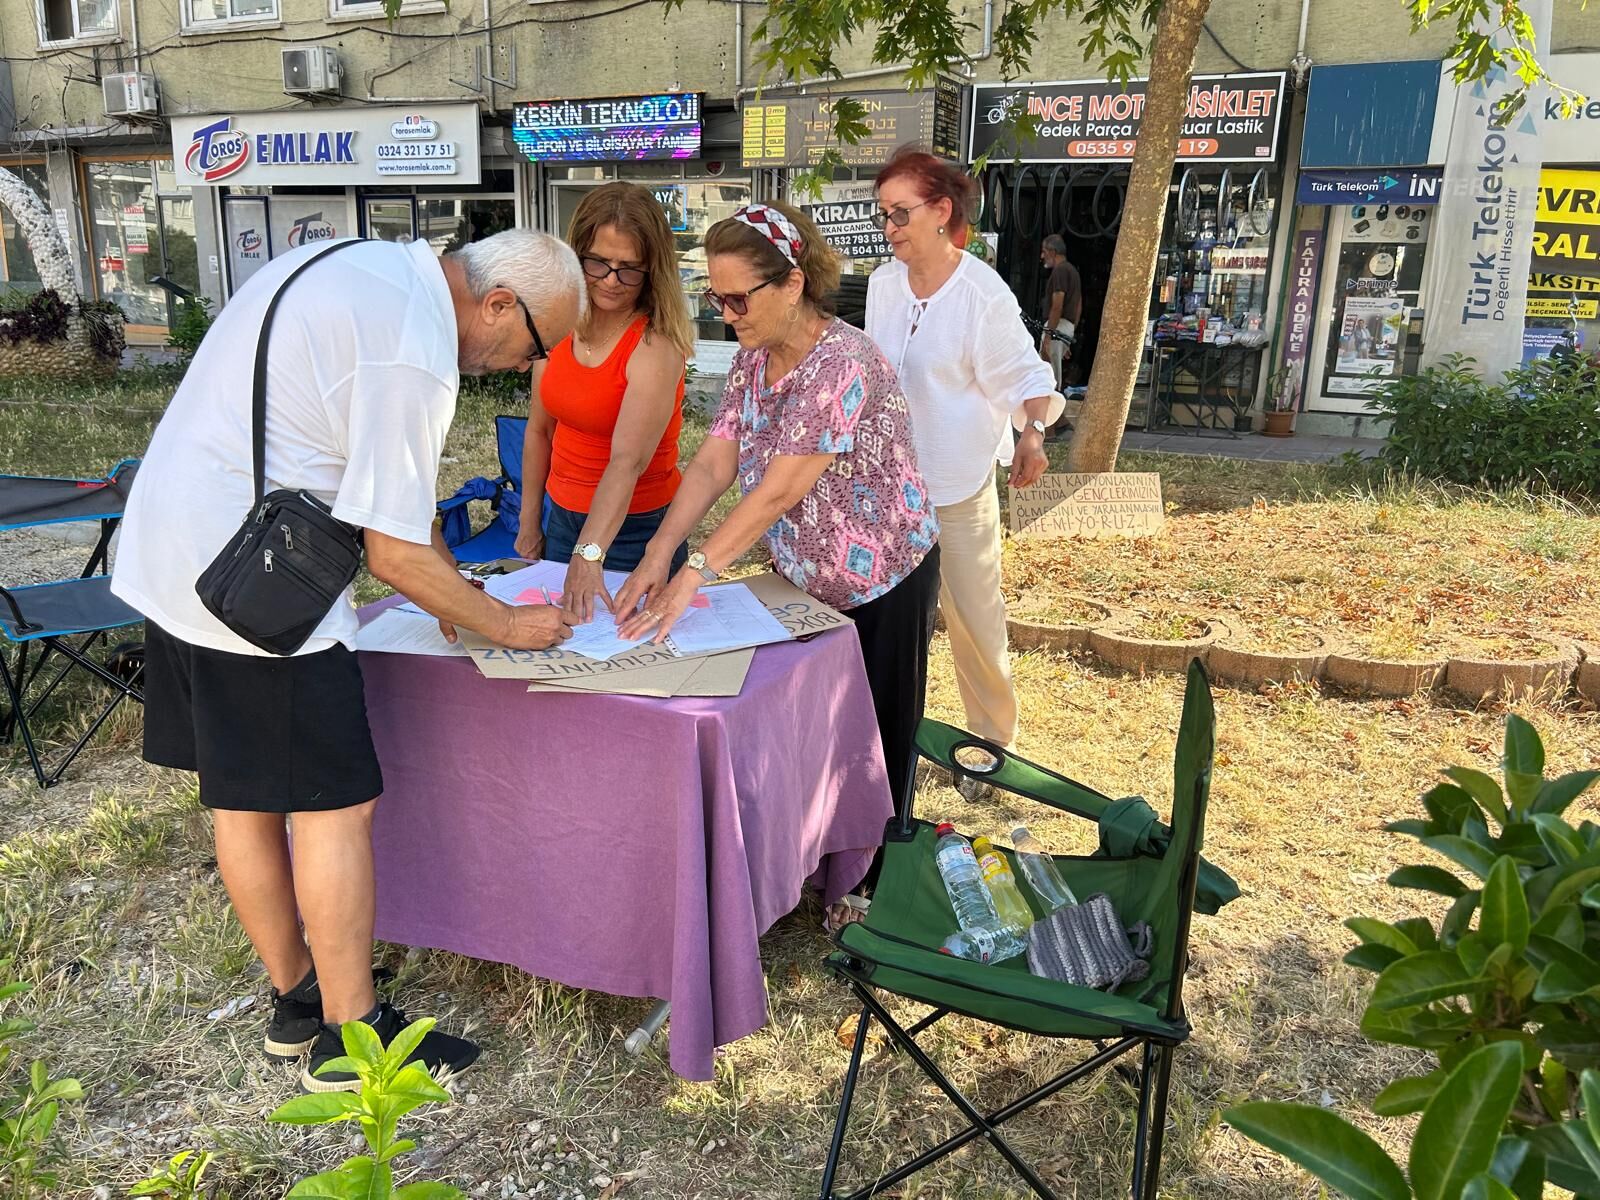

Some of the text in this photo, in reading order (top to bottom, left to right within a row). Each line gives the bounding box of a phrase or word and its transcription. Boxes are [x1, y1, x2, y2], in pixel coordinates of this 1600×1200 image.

[515, 94, 698, 127] KESKİN TEKNOLOJİ
[1026, 91, 1083, 122] İNCE
[1088, 93, 1146, 121] MOT
[395, 126, 432, 134] torosemlak
[1033, 123, 1081, 137] Yedek
[1085, 123, 1132, 140] Parça
[1216, 119, 1264, 134] Lastik
[256, 131, 354, 163] EMLAK
[378, 144, 451, 157] 0324 321 57 51
[518, 140, 567, 153] TELEFON
[568, 139, 584, 152] VE
[585, 135, 654, 151] BİLGİSAYAR
[1076, 142, 1118, 155] 0535
[1188, 141, 1209, 153] 19
[378, 163, 452, 171] www.torosemlak.com.tr
[1311, 181, 1379, 191] Türk Telekom
[834, 236, 851, 245] 532
[852, 235, 869, 243] 793
[871, 233, 884, 242] 59
[852, 246, 872, 255] 504
[874, 245, 885, 253] 16
[1493, 187, 1519, 321] Değerli Hissettirir
[1296, 237, 1316, 297] FATURA
[1461, 252, 1497, 325] Türk
[1290, 302, 1307, 352] ÖDEME
[1014, 489, 1066, 501] ALTINDA
[1076, 505, 1089, 516] VE
